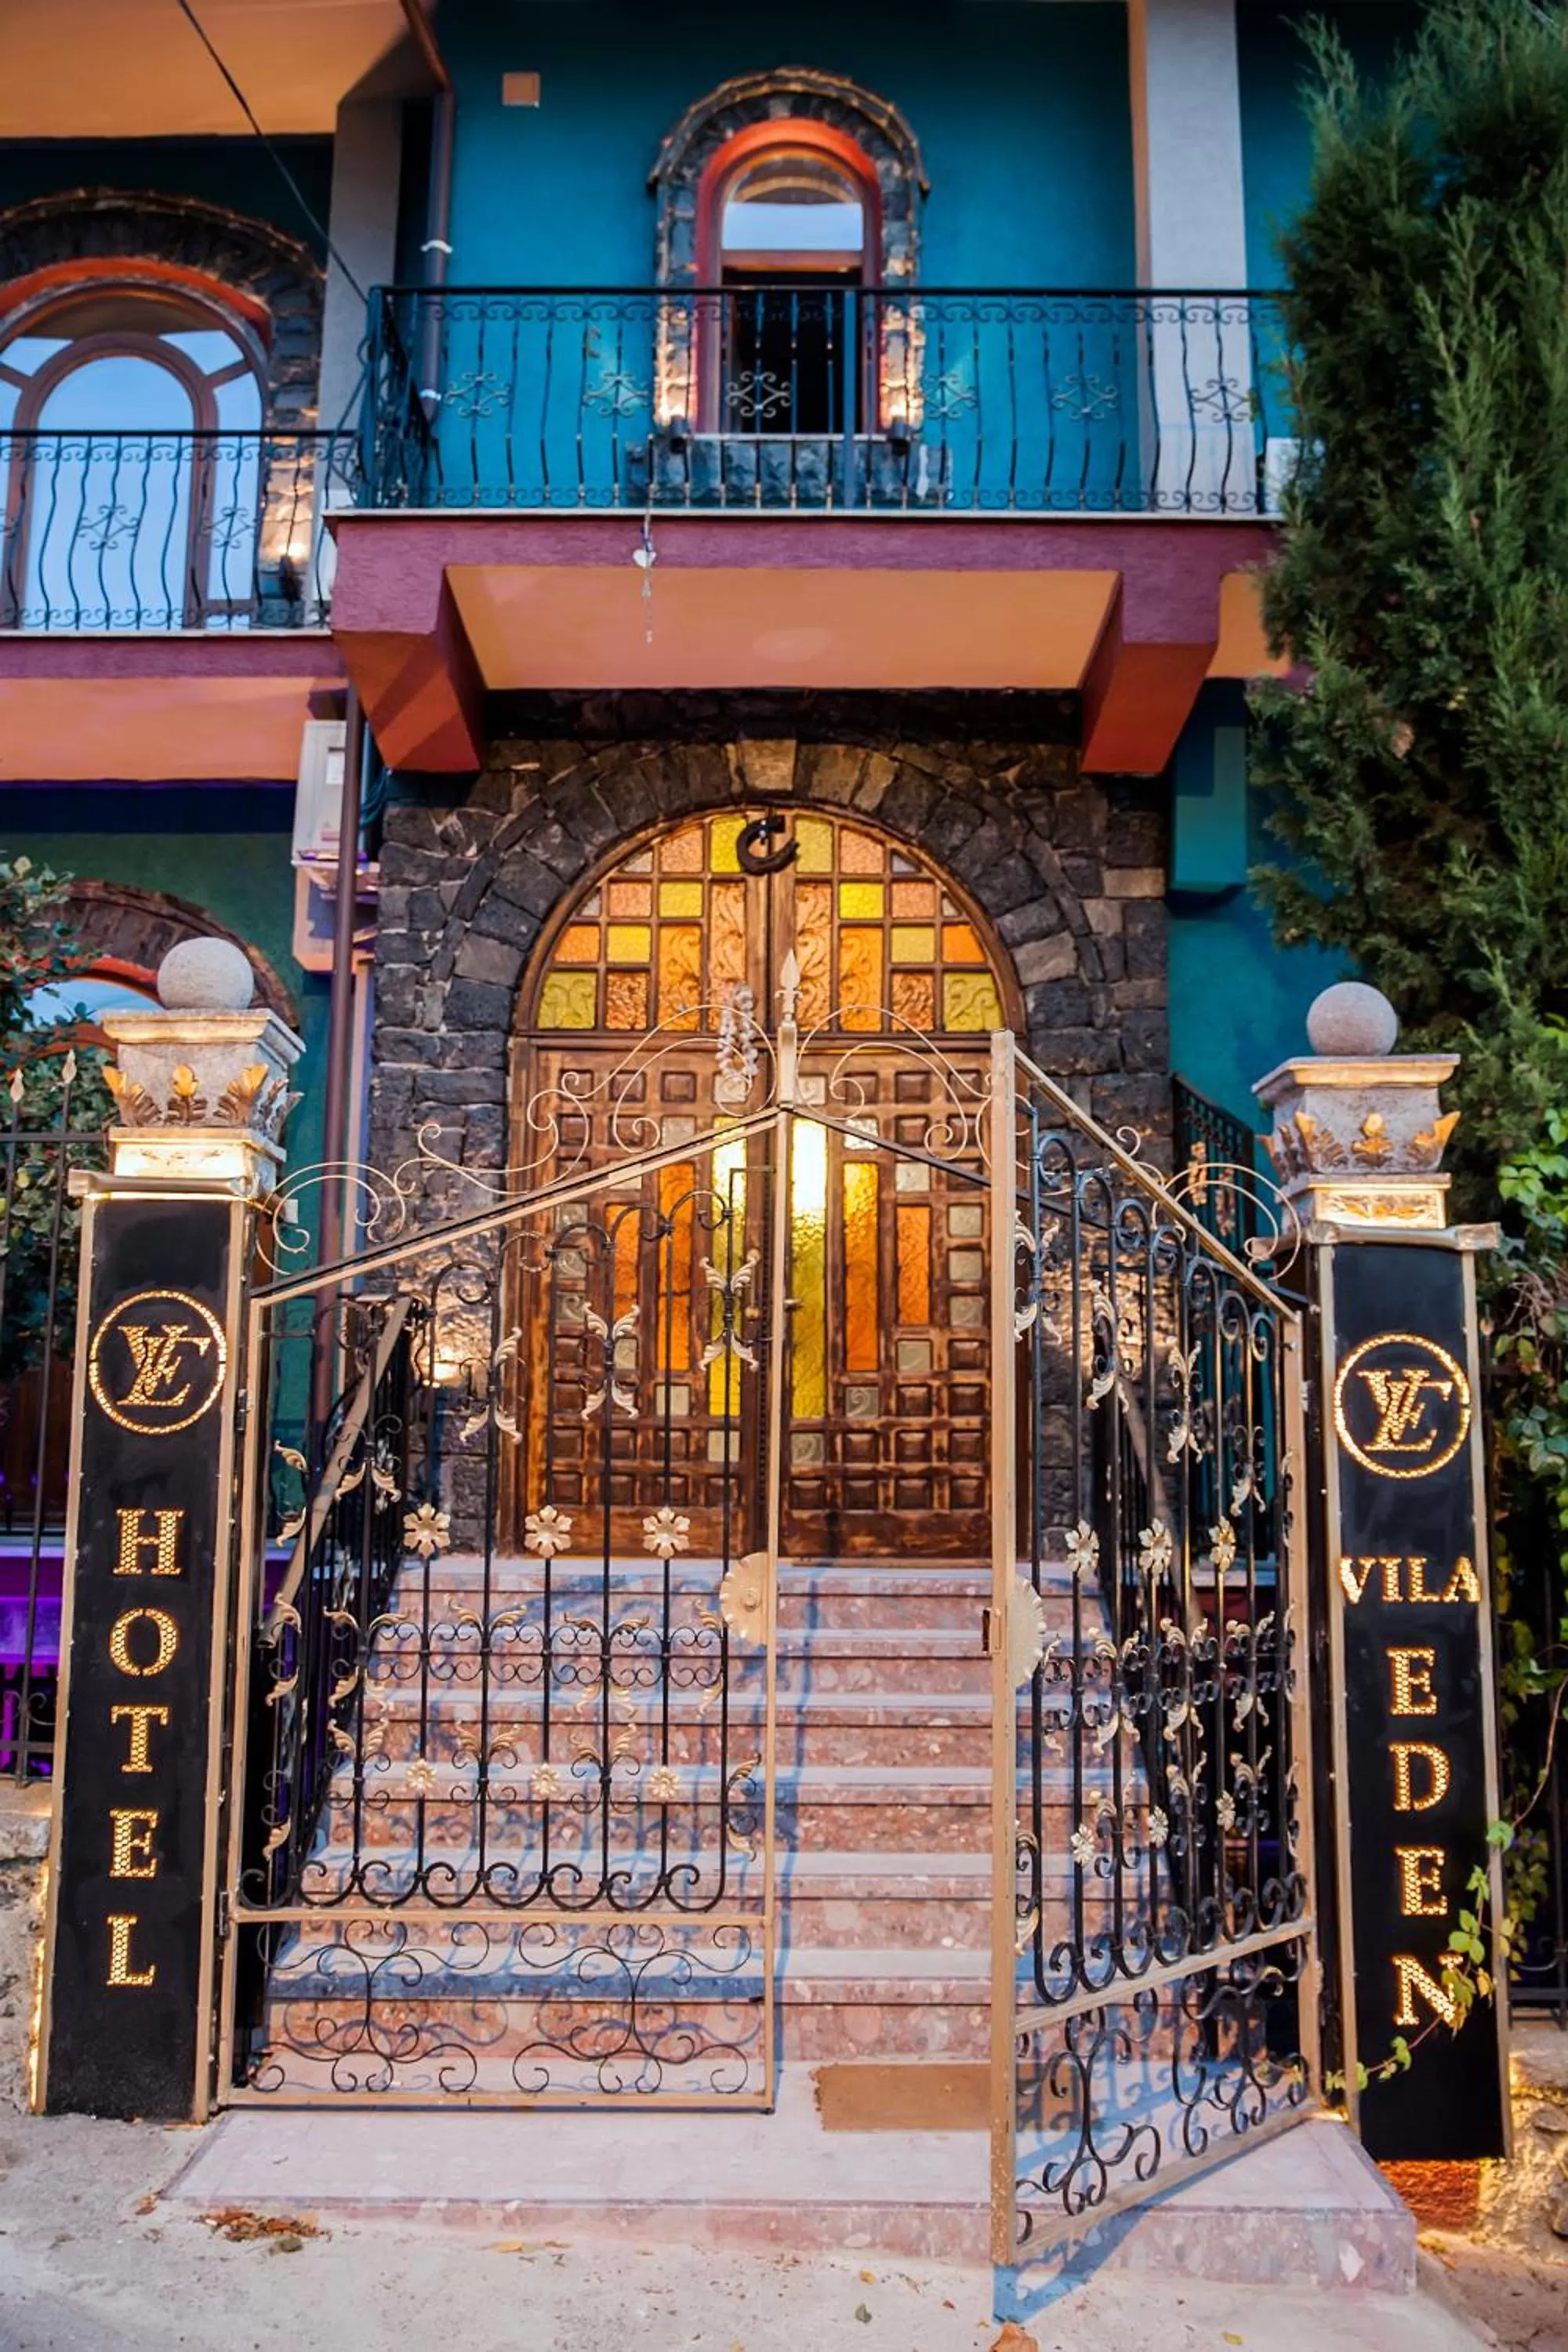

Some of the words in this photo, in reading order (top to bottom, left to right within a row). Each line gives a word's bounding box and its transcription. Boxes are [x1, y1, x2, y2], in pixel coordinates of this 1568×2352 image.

[107, 1508, 183, 1987] HOTEL
[1339, 1556, 1482, 1604] VILA
[1387, 1647, 1464, 2026] EDEN
